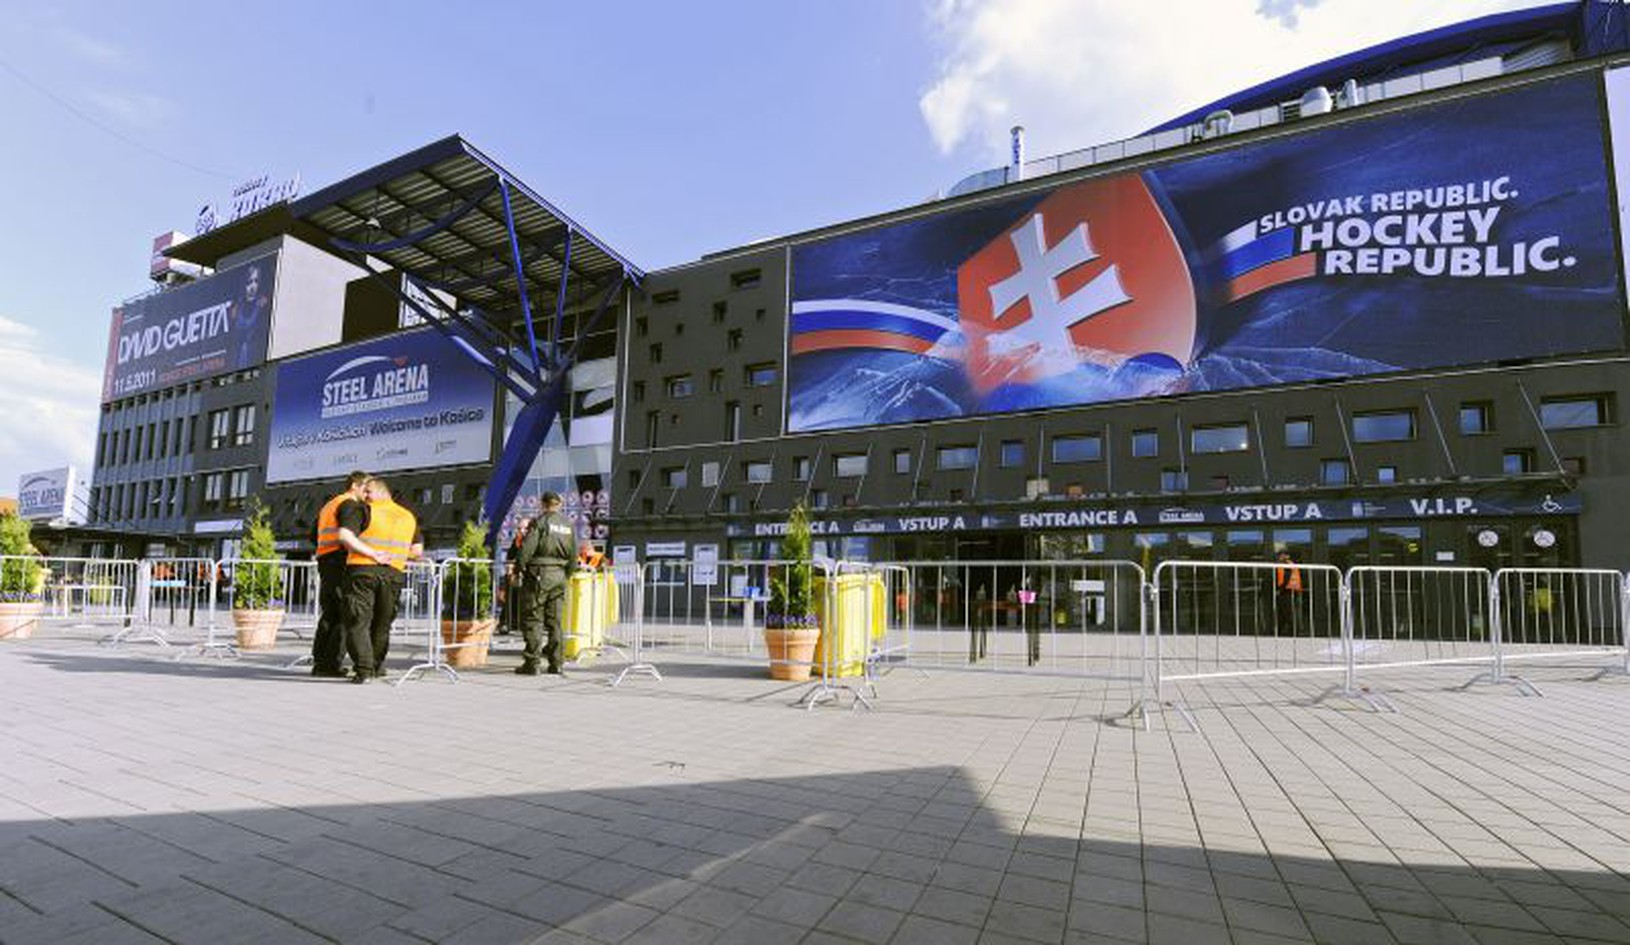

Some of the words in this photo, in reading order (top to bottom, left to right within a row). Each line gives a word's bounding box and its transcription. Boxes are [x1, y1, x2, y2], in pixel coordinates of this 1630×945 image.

[1260, 195, 1364, 234] SLOVAK
[1371, 176, 1519, 213] REPUBLIC.
[1301, 206, 1501, 252] HOCKEY
[1324, 235, 1577, 277] REPUBLIC.
[117, 325, 162, 365] DAVID
[163, 300, 233, 350] GUETTA
[323, 376, 368, 407] STEEL
[372, 363, 429, 398] ARENA
[369, 417, 422, 435] Welcome
[423, 415, 439, 428] to
[1225, 504, 1299, 521] VSTUP
[1303, 502, 1323, 519] A
[1409, 497, 1478, 516] V.I.P.
[755, 521, 825, 536] ENTRCE
[828, 520, 840, 534] A
[898, 517, 949, 531] VSTUP
[953, 516, 966, 530] A
[1019, 509, 1118, 527] ENTRANCE
[1122, 509, 1139, 525] A
